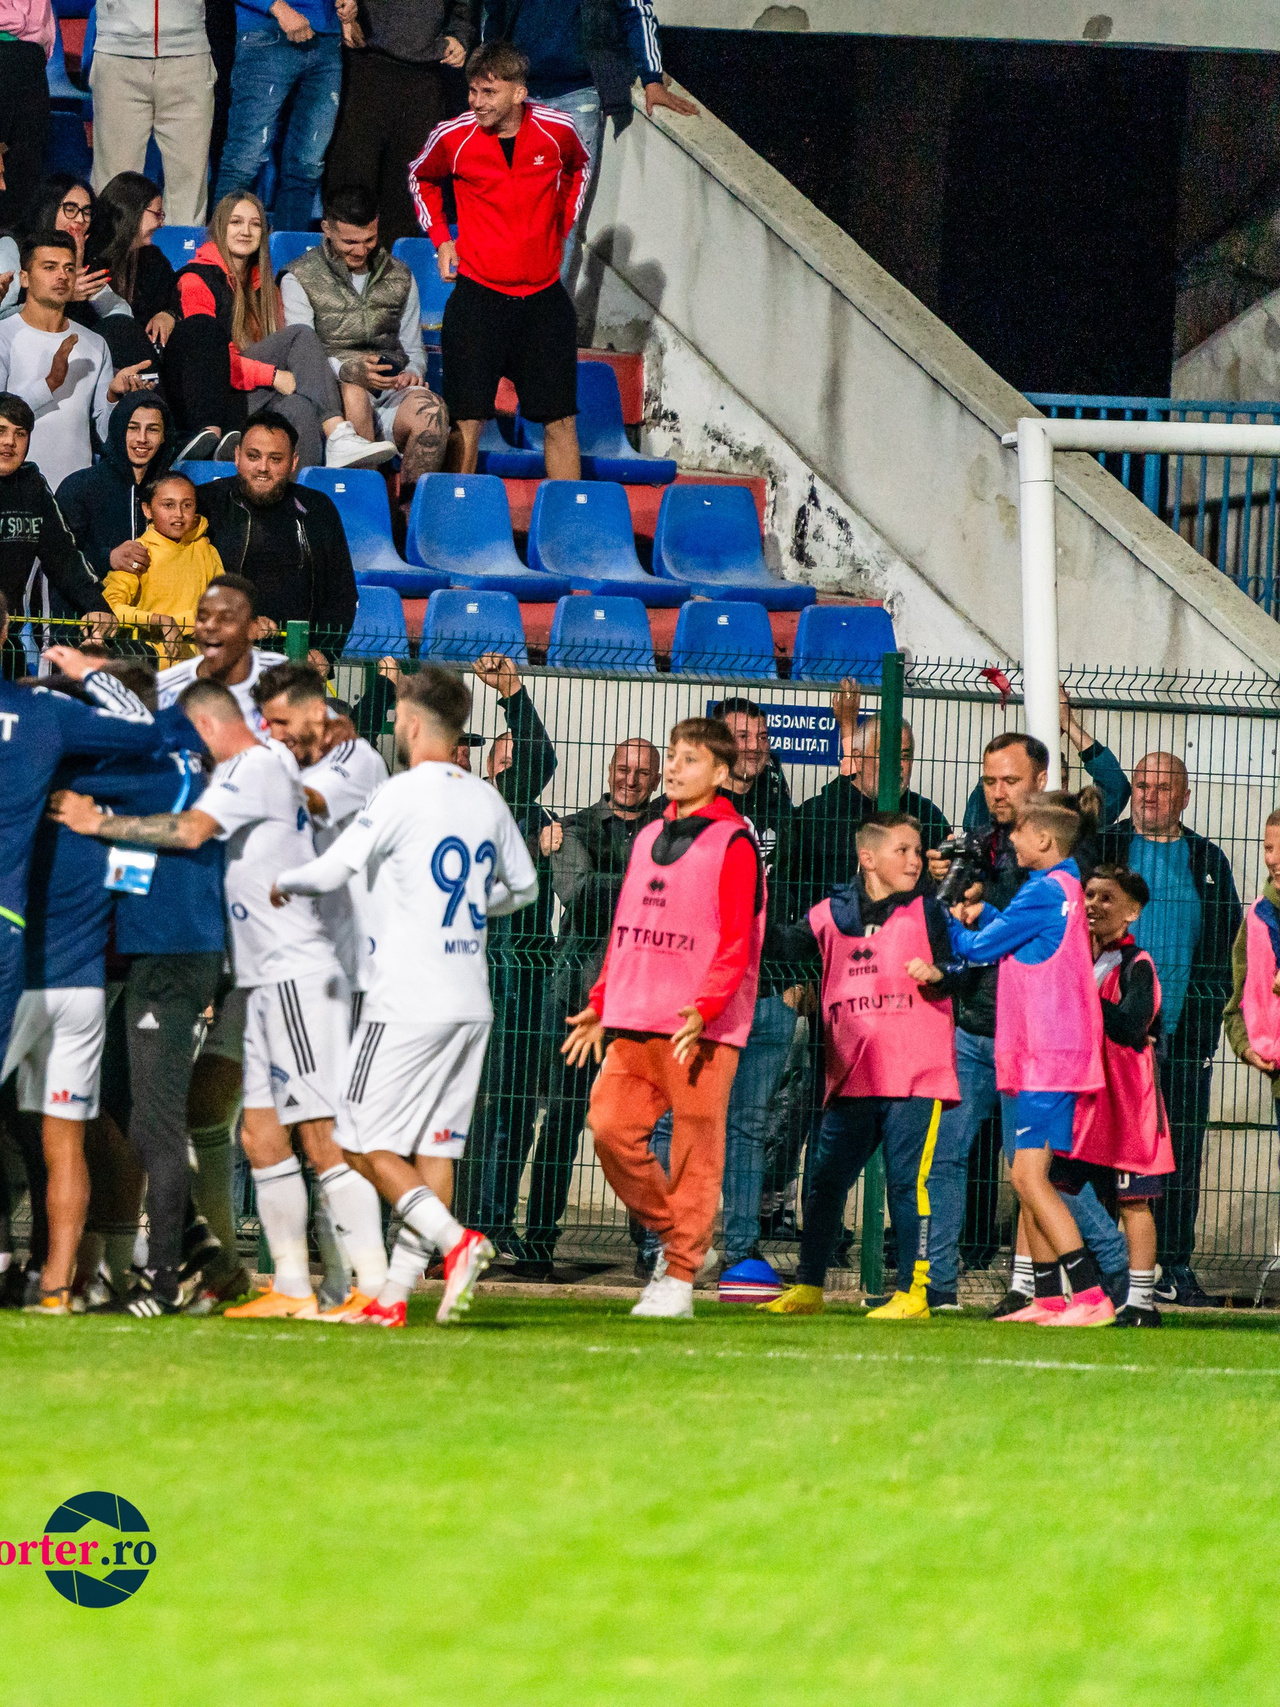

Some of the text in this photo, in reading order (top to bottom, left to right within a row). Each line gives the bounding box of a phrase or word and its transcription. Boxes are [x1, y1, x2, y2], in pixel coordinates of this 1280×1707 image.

[431, 835, 497, 930] 93
[633, 927, 694, 951] TRUTZI
[847, 994, 913, 1013] TRUTZI
